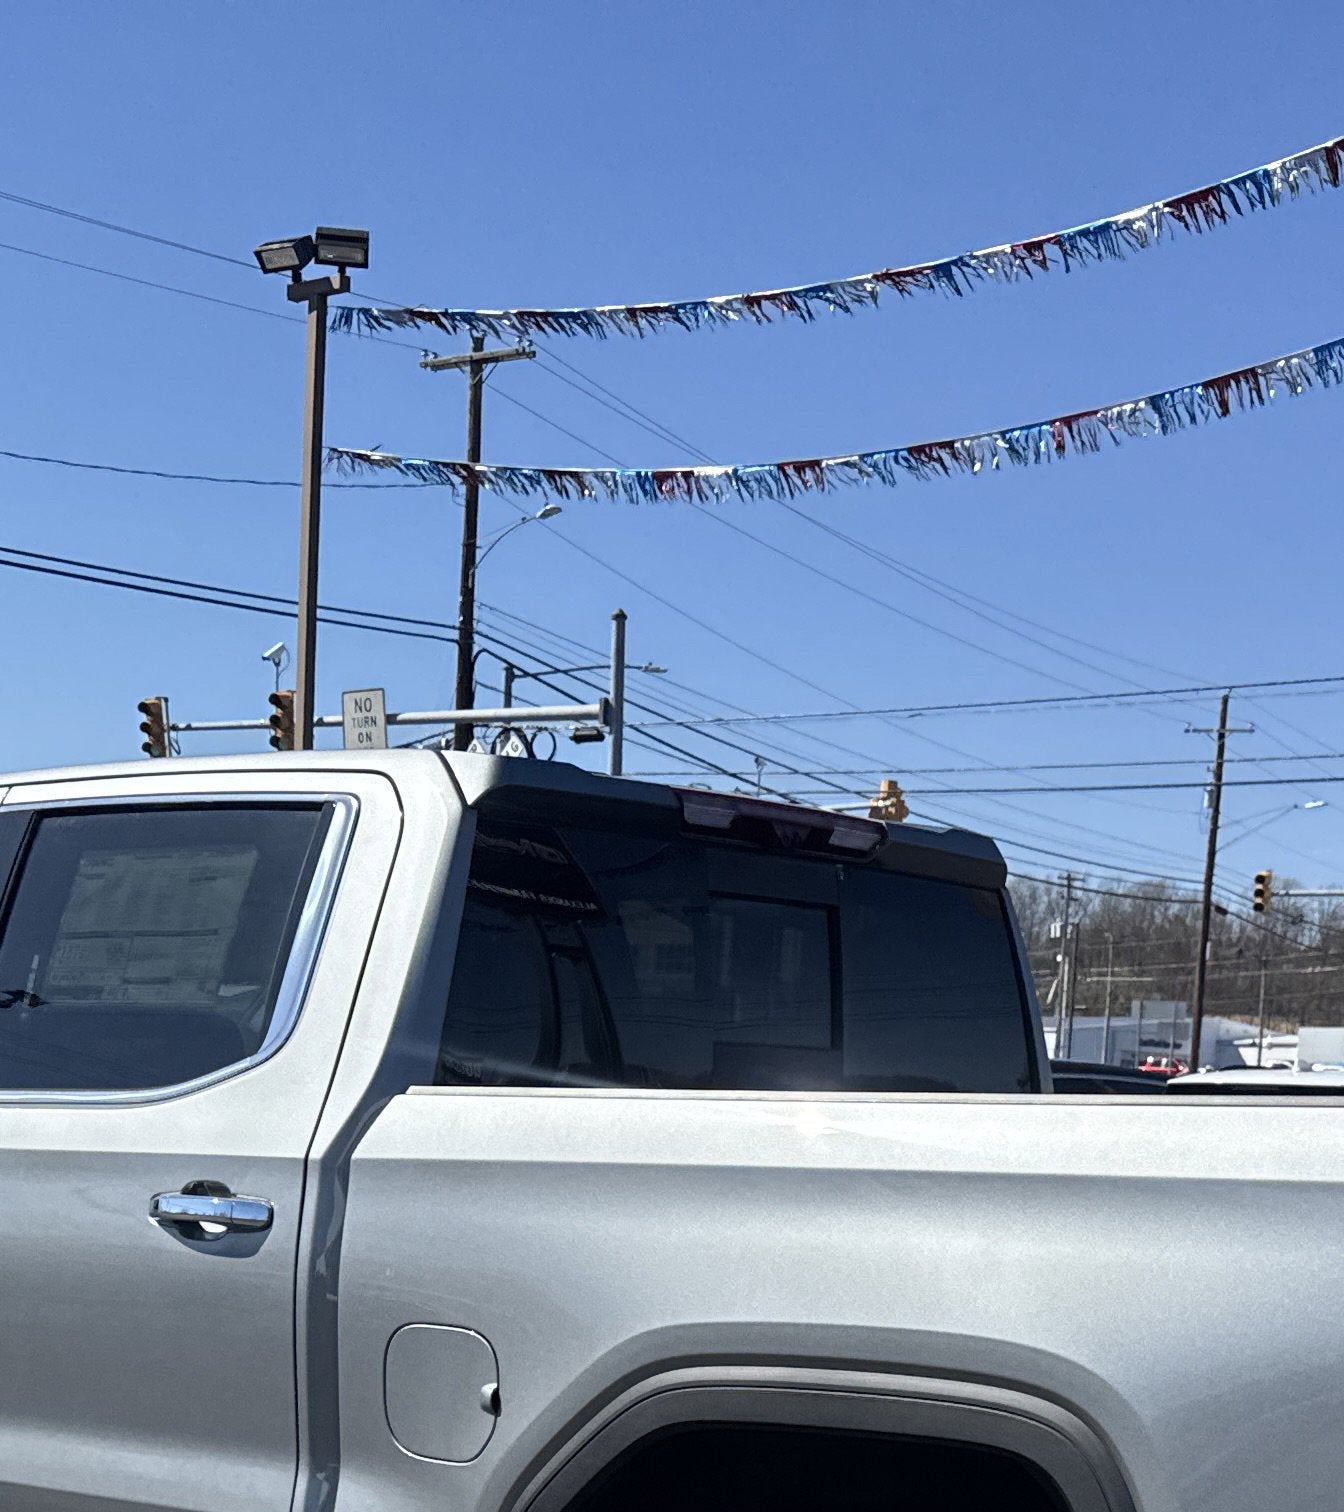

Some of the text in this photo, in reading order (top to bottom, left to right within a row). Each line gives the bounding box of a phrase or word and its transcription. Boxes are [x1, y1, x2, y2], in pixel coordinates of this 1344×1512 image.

[354, 697, 373, 713] NO
[351, 716, 377, 729] TURN
[357, 731, 372, 744] ON
